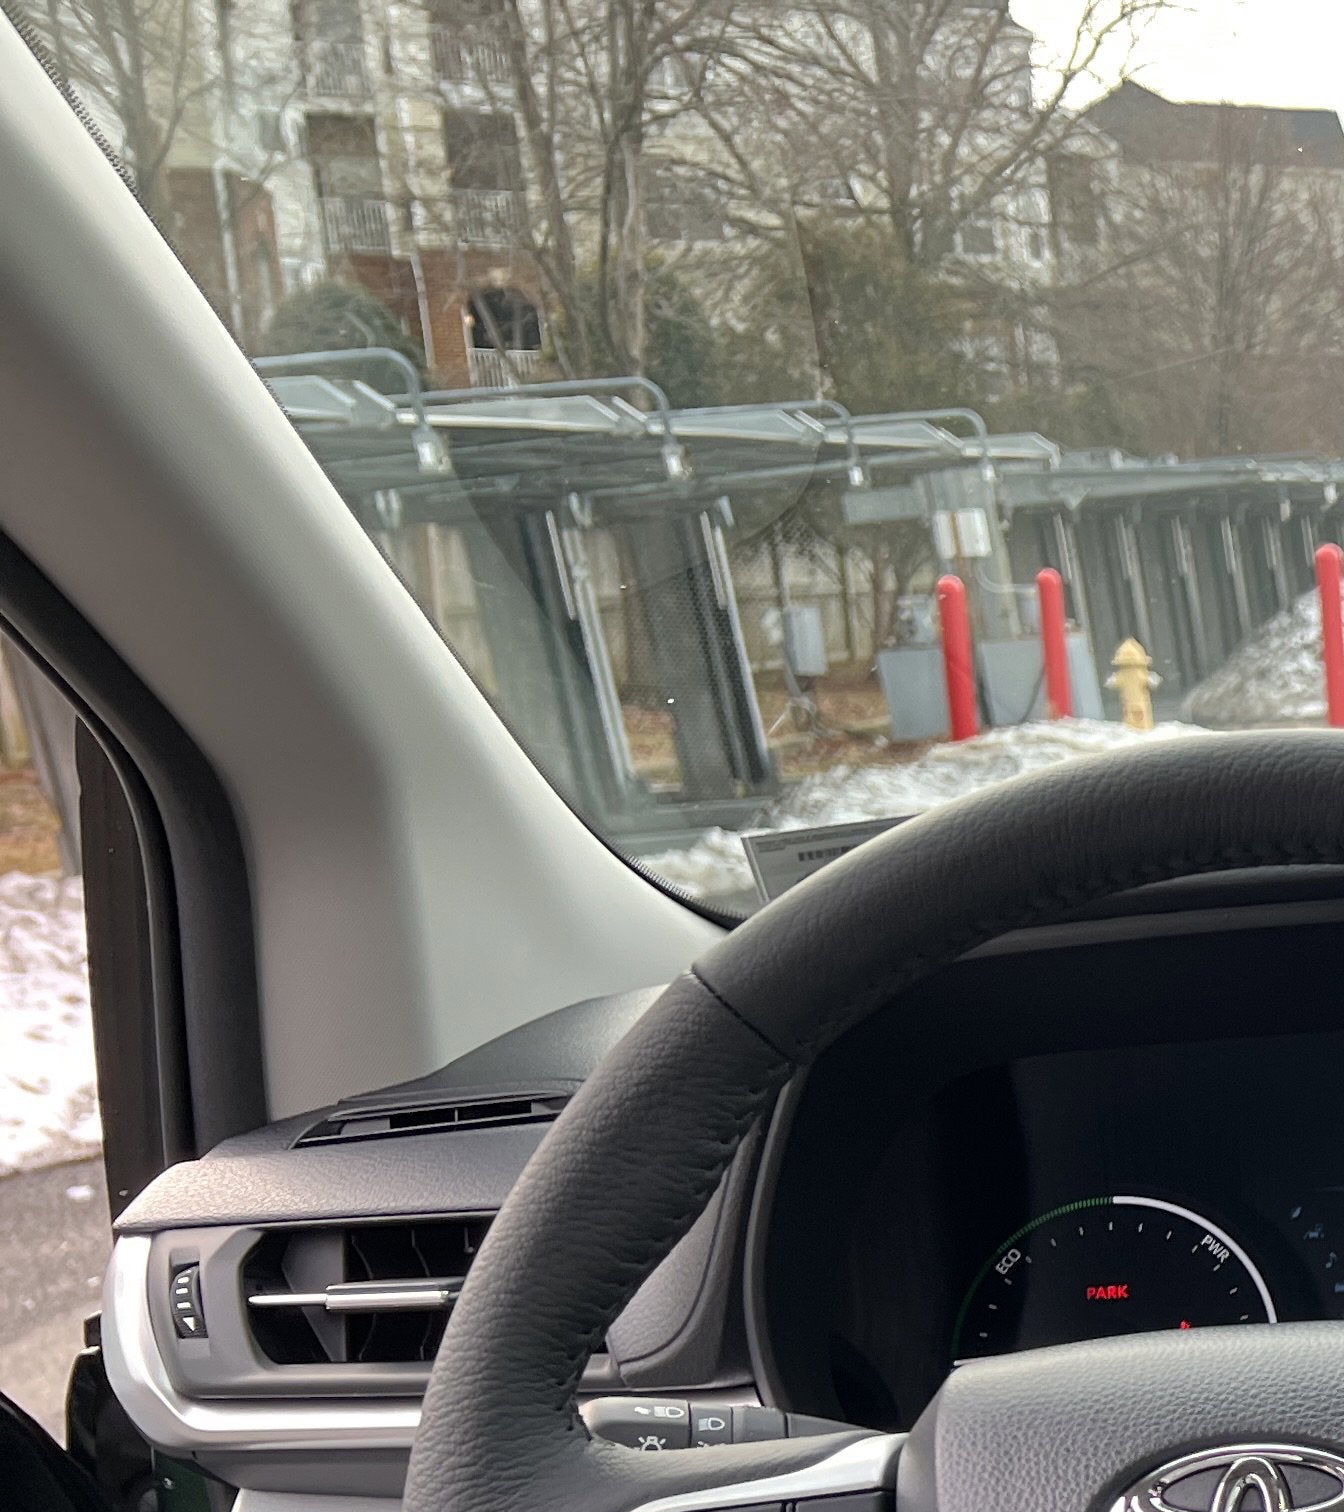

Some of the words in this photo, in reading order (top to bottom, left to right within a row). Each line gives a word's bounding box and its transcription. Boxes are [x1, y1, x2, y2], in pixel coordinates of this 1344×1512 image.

[995, 1248, 1021, 1275] ECO
[1201, 1234, 1231, 1263] PWR
[1086, 1284, 1130, 1300] PARK
